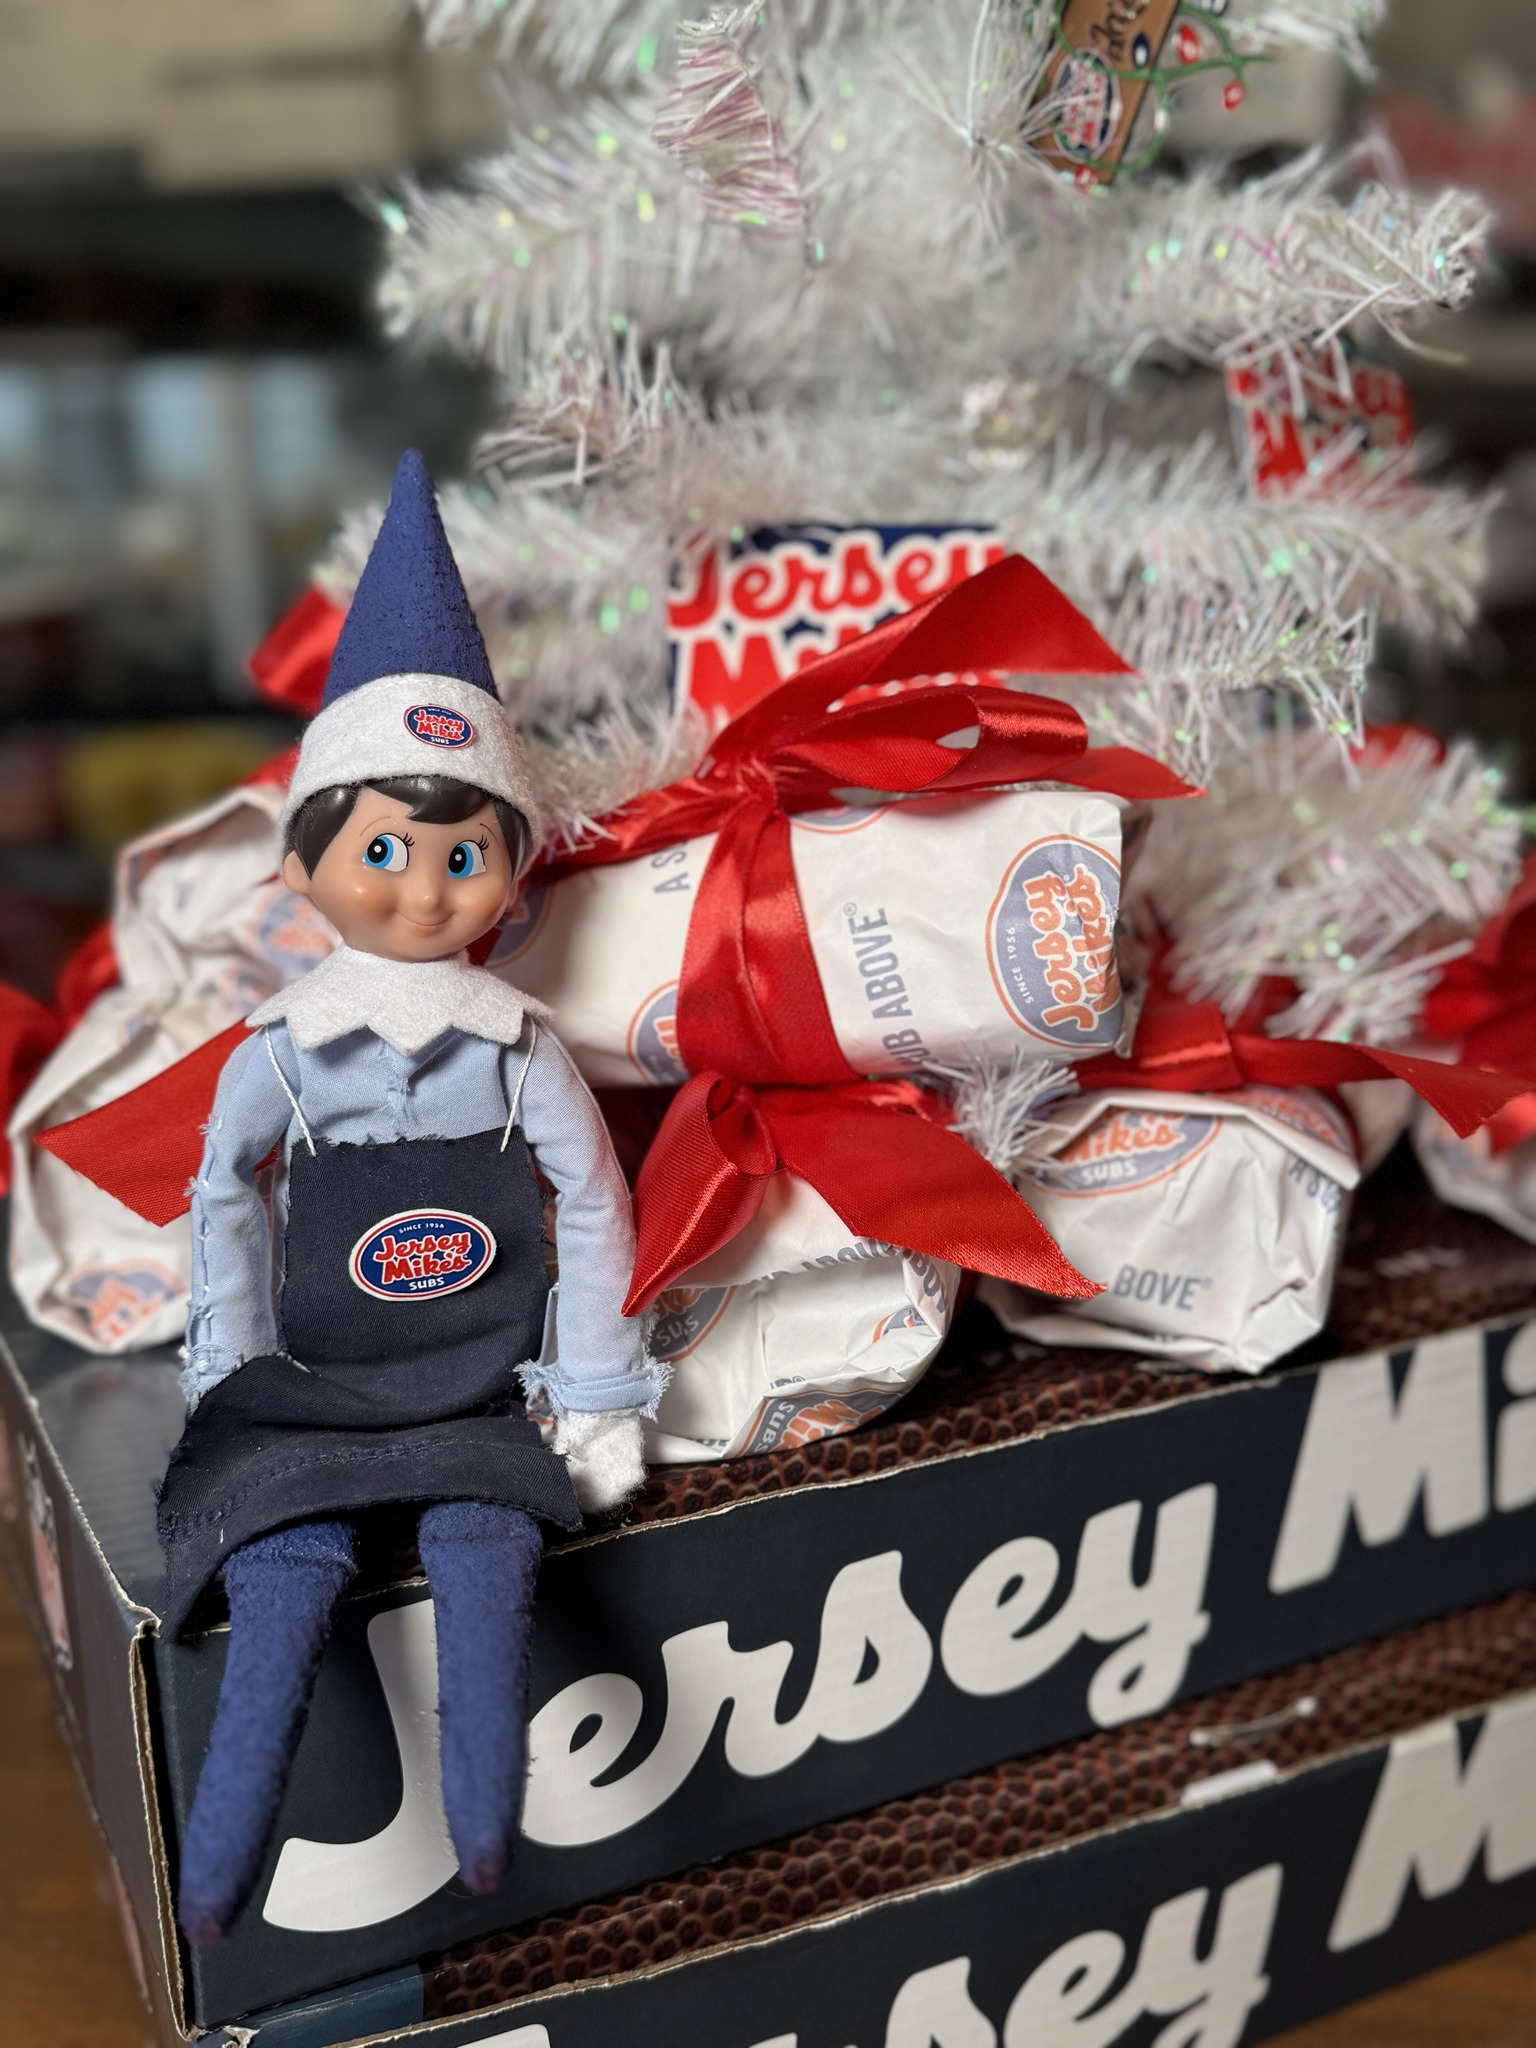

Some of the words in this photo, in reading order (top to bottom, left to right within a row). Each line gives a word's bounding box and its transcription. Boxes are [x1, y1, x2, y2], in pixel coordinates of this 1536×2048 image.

[414, 709, 464, 732] Jersey
[430, 737, 450, 745] SUBS
[1006, 926, 1016, 960] 1956
[1022, 871, 1098, 1031] Jersey
[1012, 966, 1034, 1004] SINCE
[1081, 1159, 1138, 1185] SUBS
[399, 1223, 422, 1234] SINCE
[372, 1232, 472, 1262] Jersey
[408, 1277, 445, 1291] SUBS
